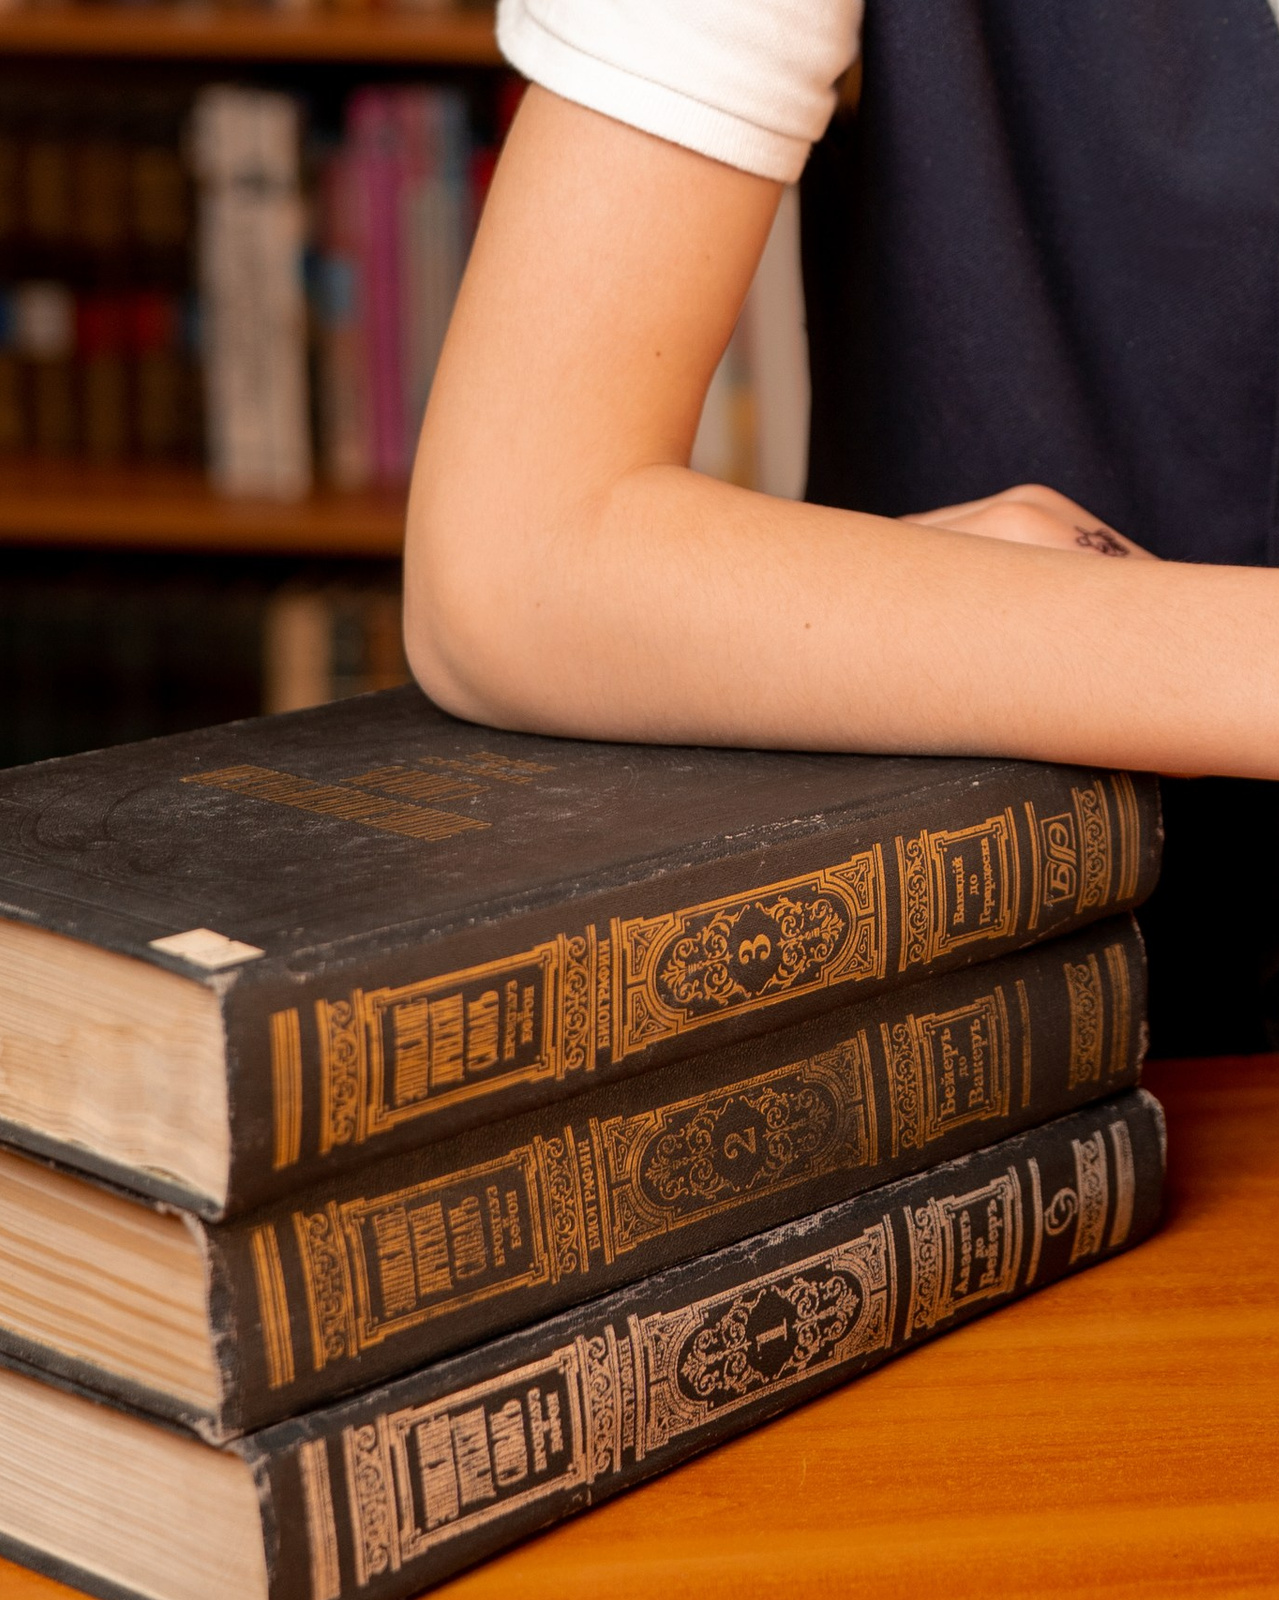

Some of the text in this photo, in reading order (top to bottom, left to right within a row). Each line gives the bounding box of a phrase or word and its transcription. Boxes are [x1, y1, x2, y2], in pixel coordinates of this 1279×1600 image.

[969, 873, 980, 895] до
[738, 933, 772, 966] 3
[598, 938, 611, 1049] БИОГРАФИИ
[467, 990, 499, 1071] СЛОВАРЬ
[958, 1056, 968, 1077] до
[723, 1126, 758, 1161] 2
[578, 1139, 601, 1250] БИОГРАФИИ
[449, 1195, 488, 1280] СЛОВАРЬ
[755, 1318, 788, 1352] 1
